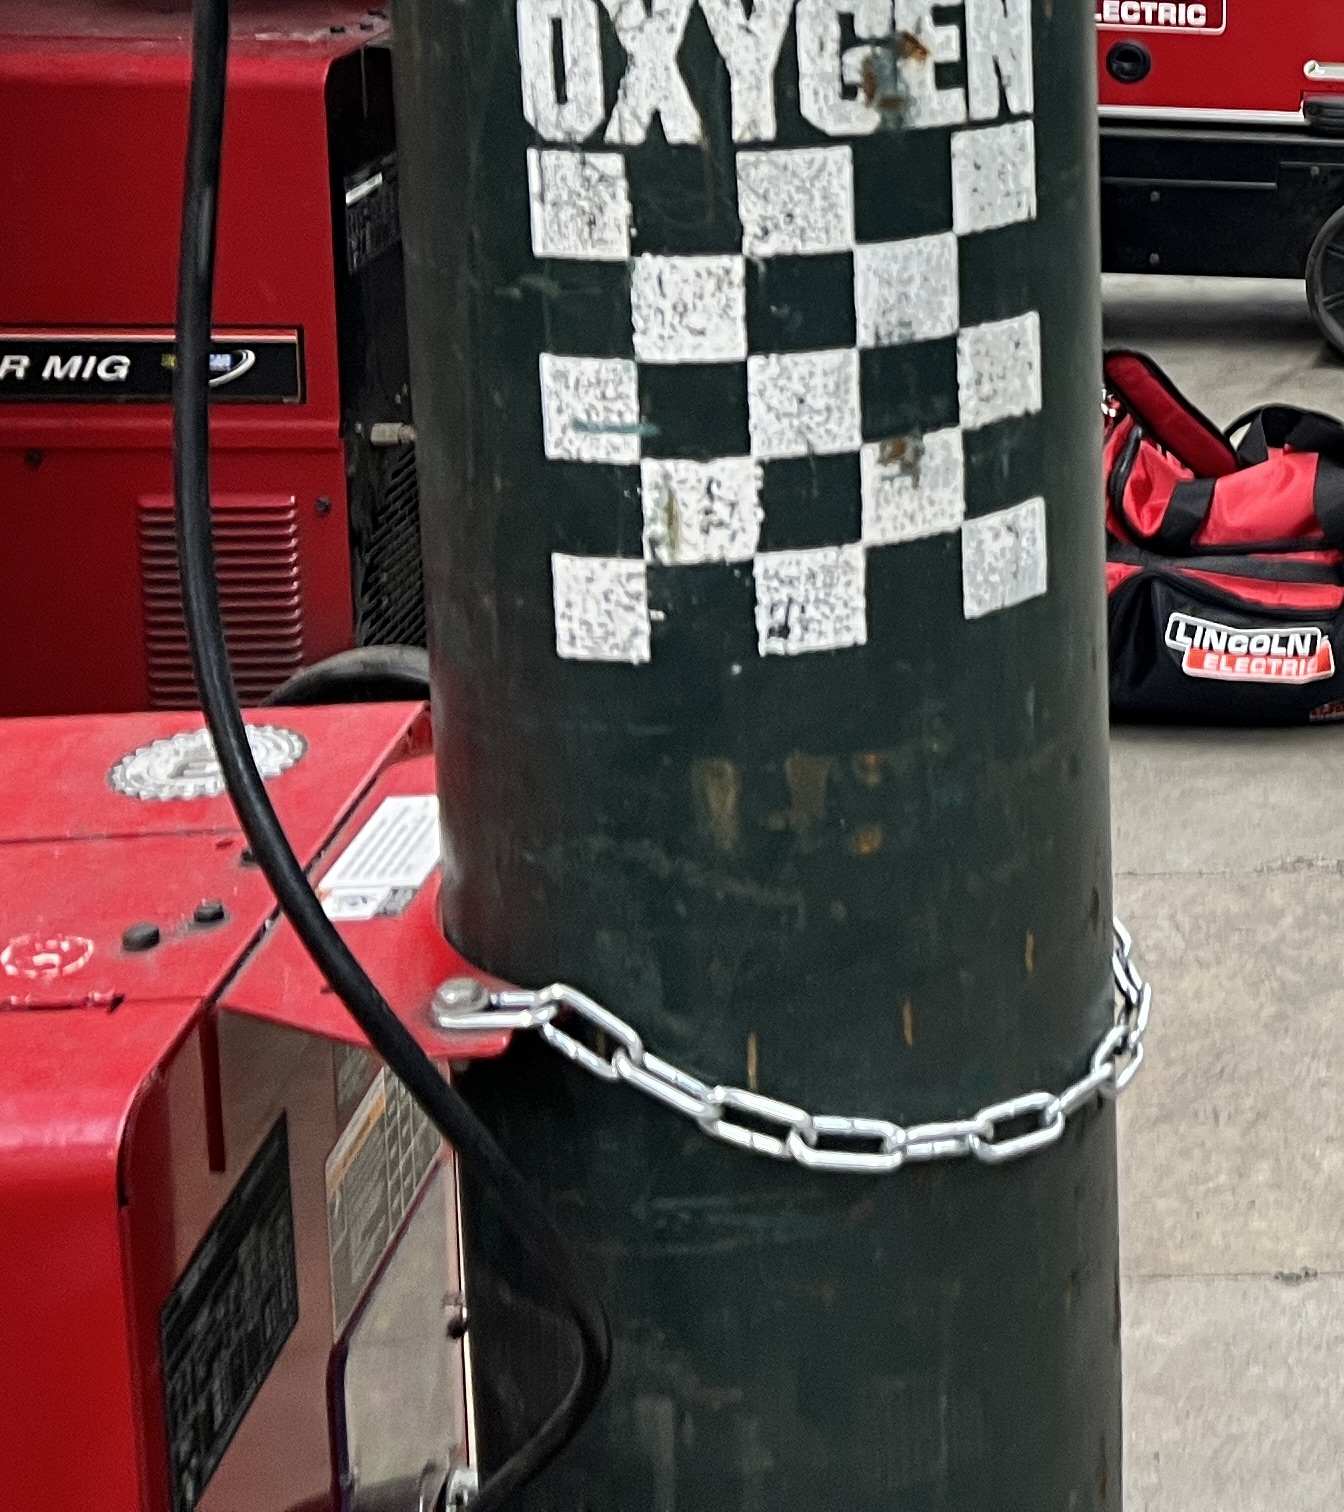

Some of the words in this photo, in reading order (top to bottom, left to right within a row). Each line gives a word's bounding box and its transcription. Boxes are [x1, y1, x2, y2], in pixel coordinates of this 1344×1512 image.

[41, 354, 131, 382] MIG
[1175, 621, 1311, 658] LINCOLN
[1203, 652, 1318, 678] ELECTRIC
